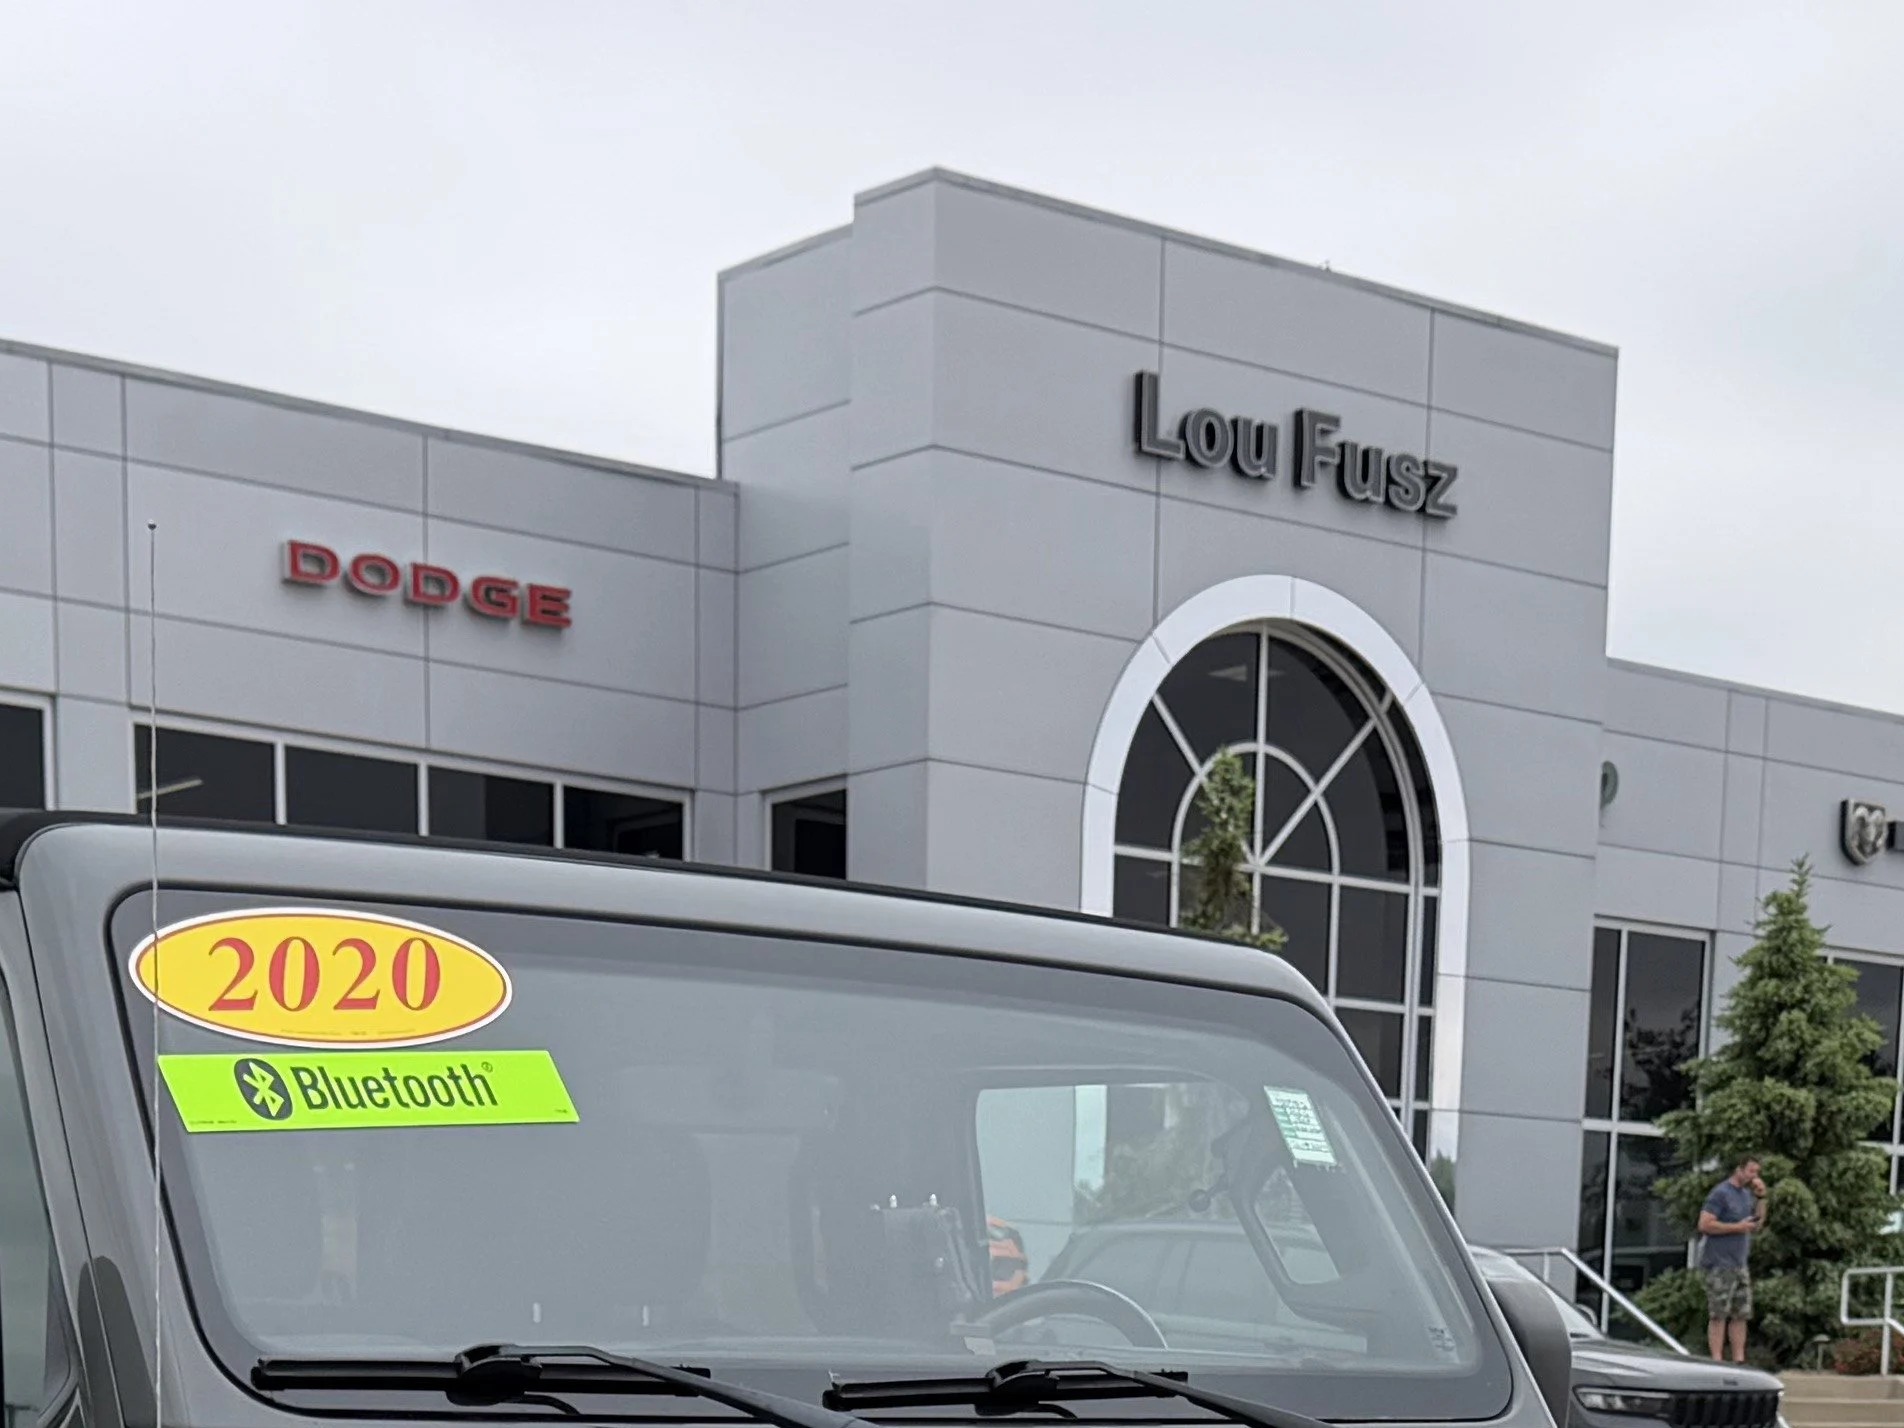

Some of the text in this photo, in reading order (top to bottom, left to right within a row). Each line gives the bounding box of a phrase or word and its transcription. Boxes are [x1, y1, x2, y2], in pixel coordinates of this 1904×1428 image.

[1132, 370, 1459, 519] Lou Fusz
[283, 539, 573, 628] DODGE
[207, 935, 442, 1013] 2020
